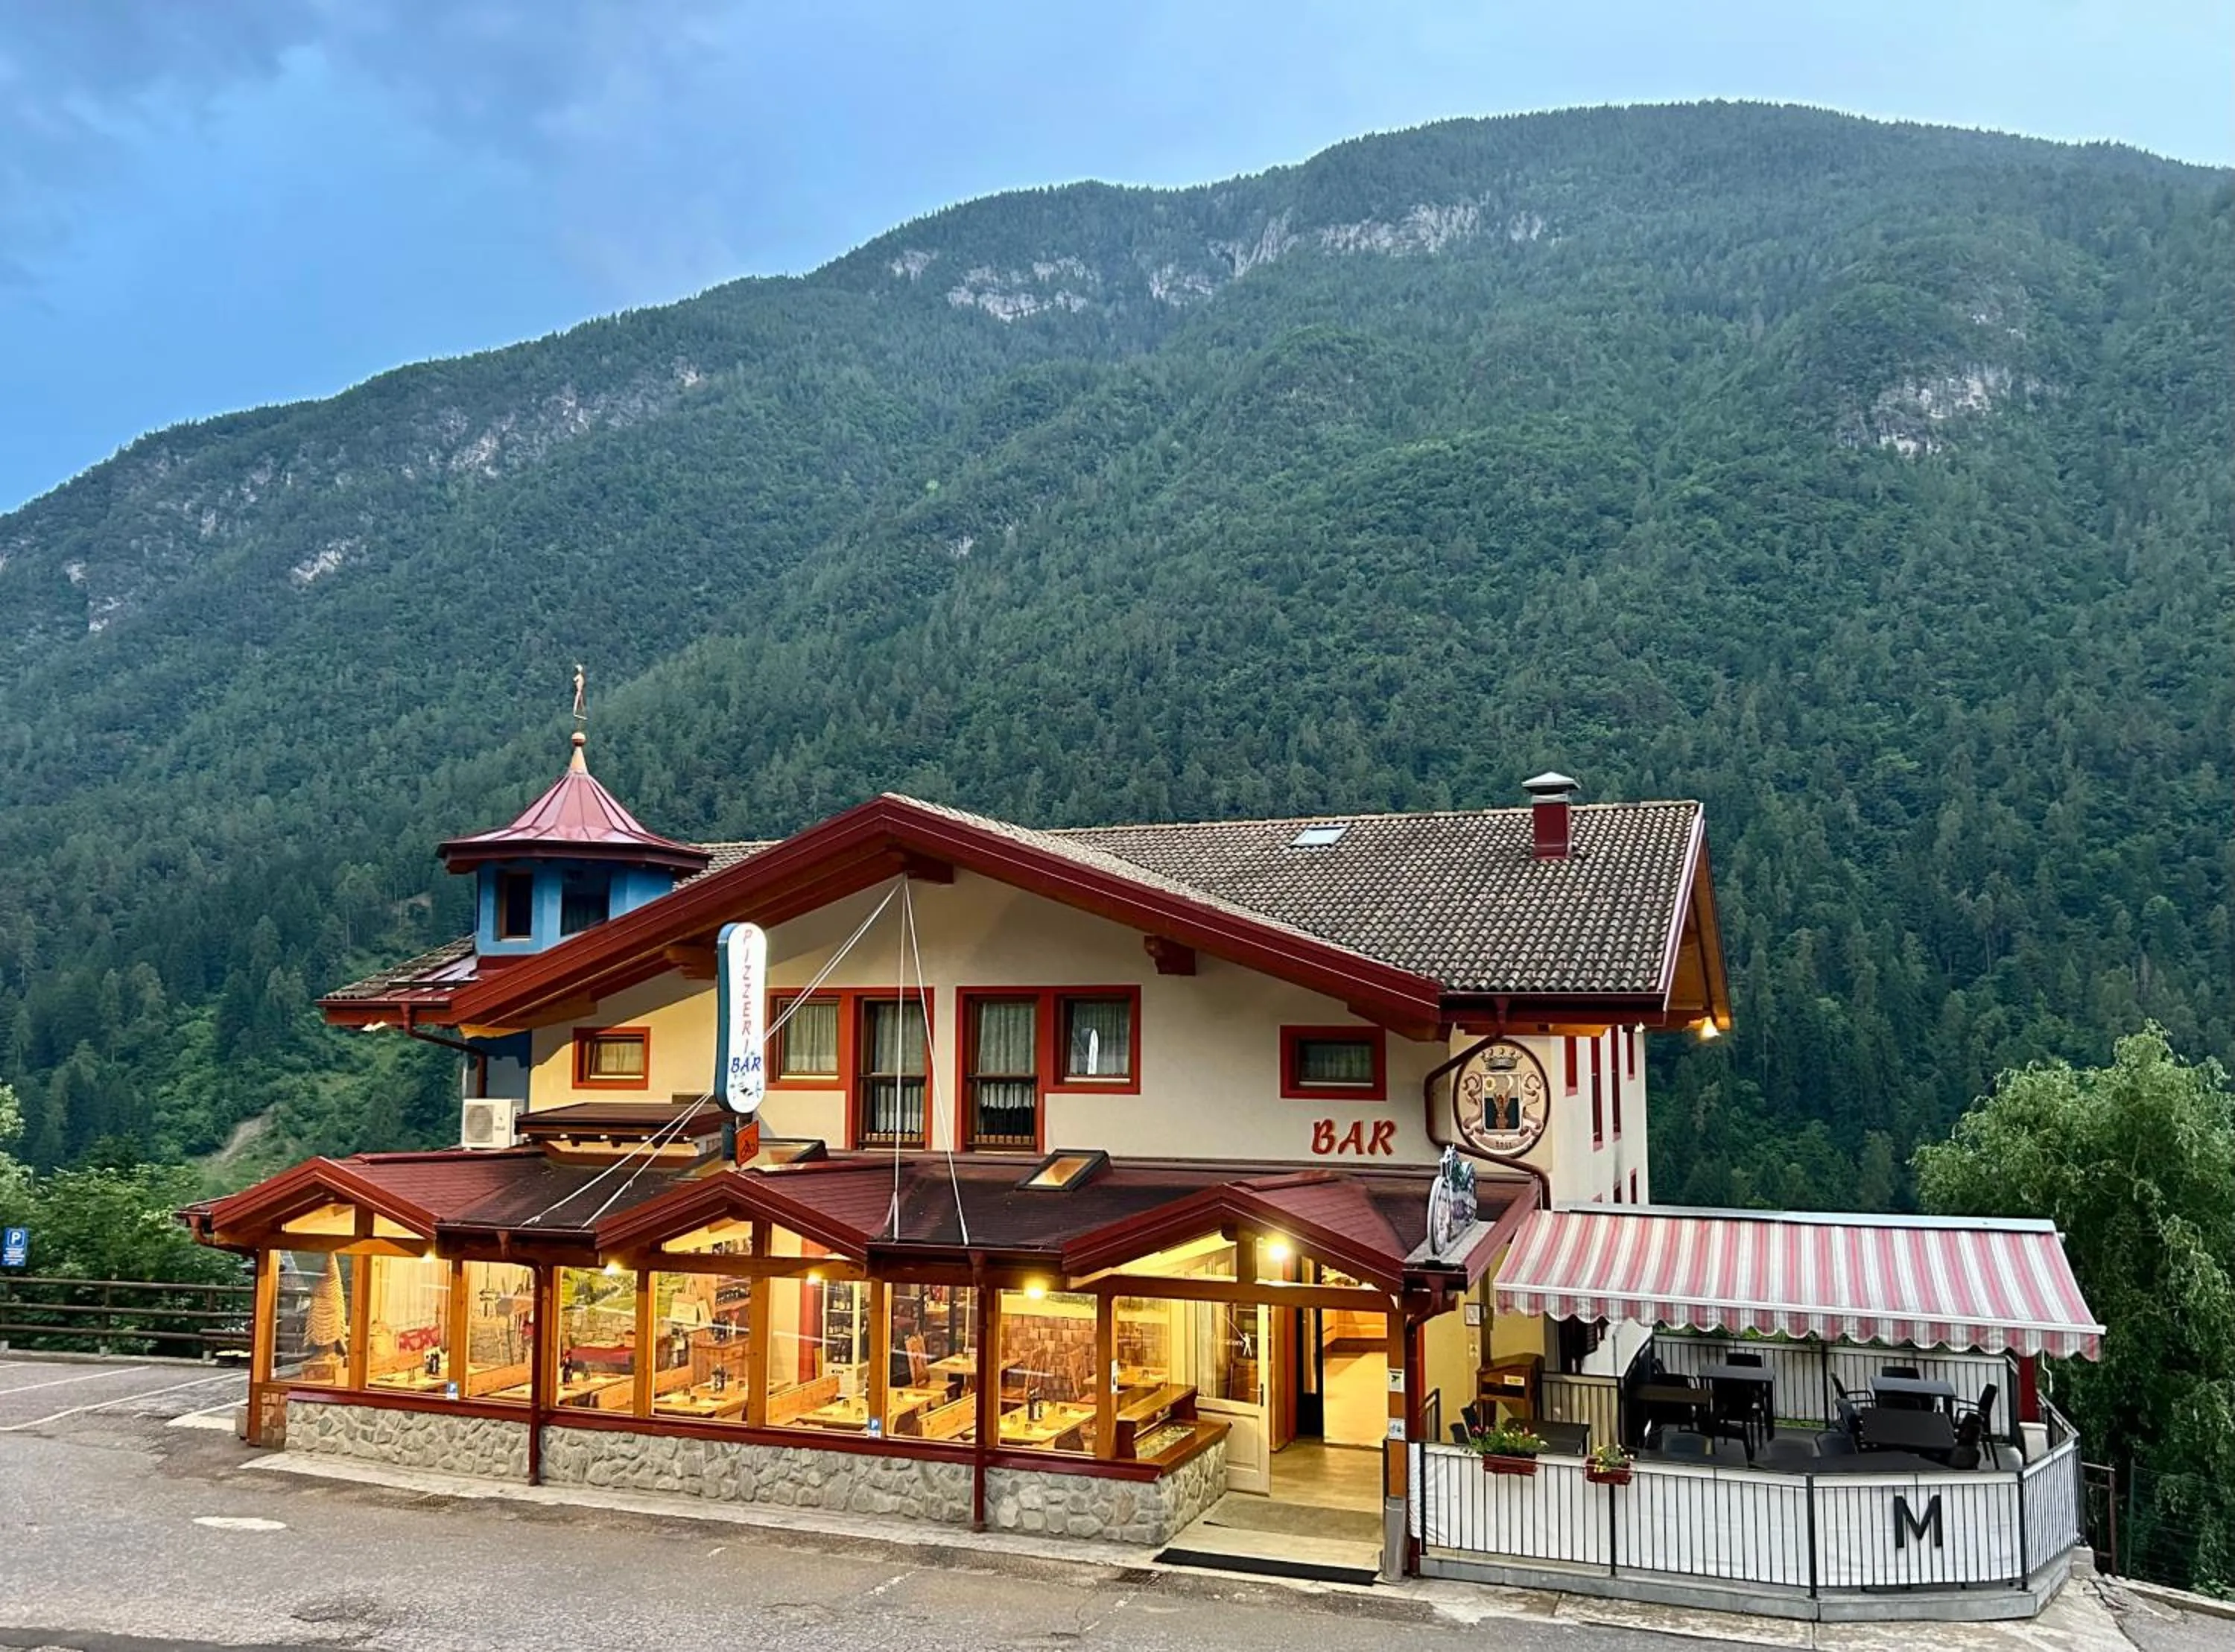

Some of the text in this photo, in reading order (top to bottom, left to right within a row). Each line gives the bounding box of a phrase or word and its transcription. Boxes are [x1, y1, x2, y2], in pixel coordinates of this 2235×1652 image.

[731, 1056, 761, 1073] BAR
[1311, 1119, 1397, 1156] BAR
[11, 1231, 22, 1245] P
[1894, 1495, 1943, 1548] M
